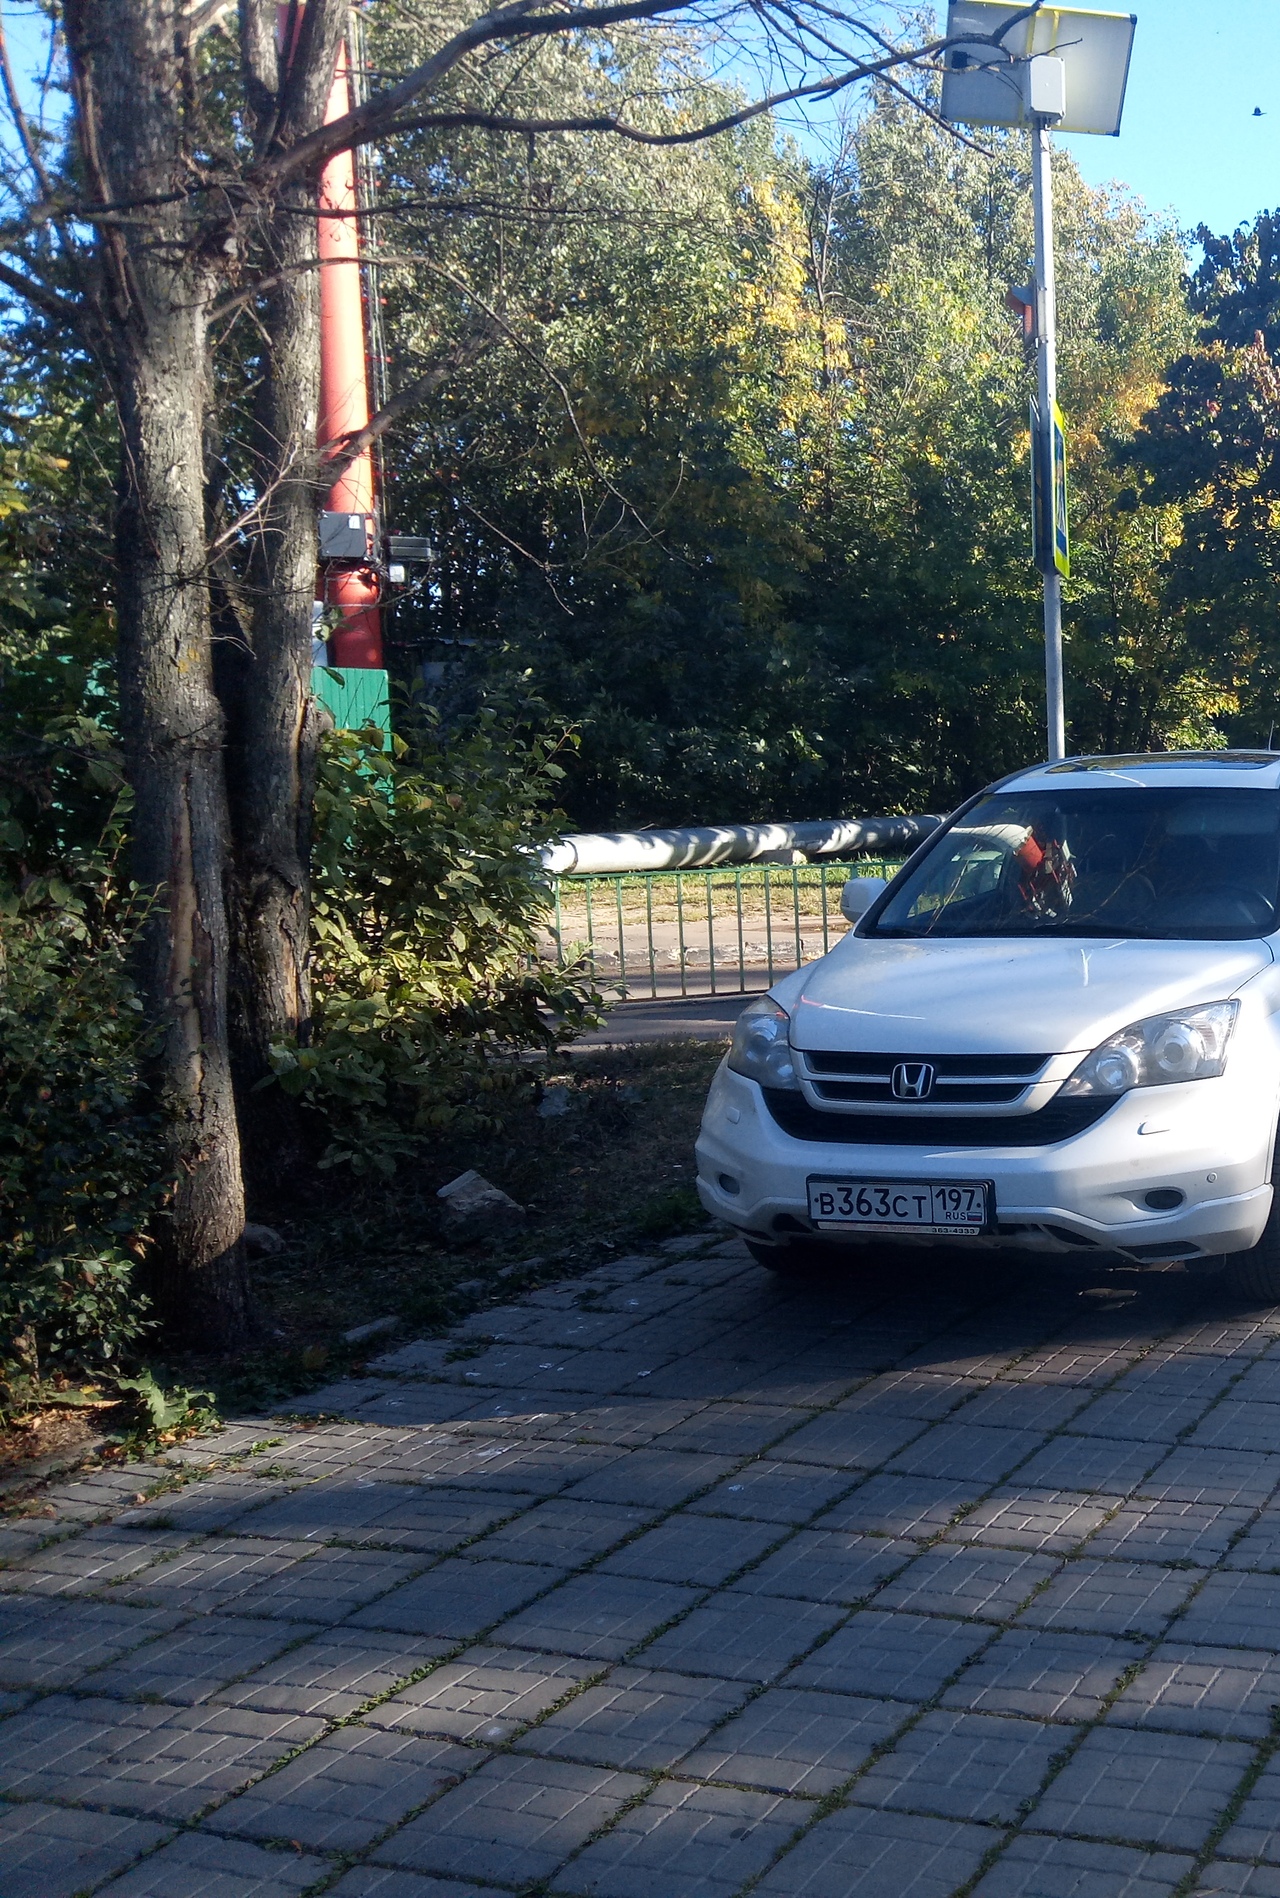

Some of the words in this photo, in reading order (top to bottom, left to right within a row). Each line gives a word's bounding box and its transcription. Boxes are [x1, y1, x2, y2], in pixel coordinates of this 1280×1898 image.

[818, 1187, 927, 1219] В363СТ
[935, 1188, 976, 1211] 197
[945, 1211, 966, 1221] RUS
